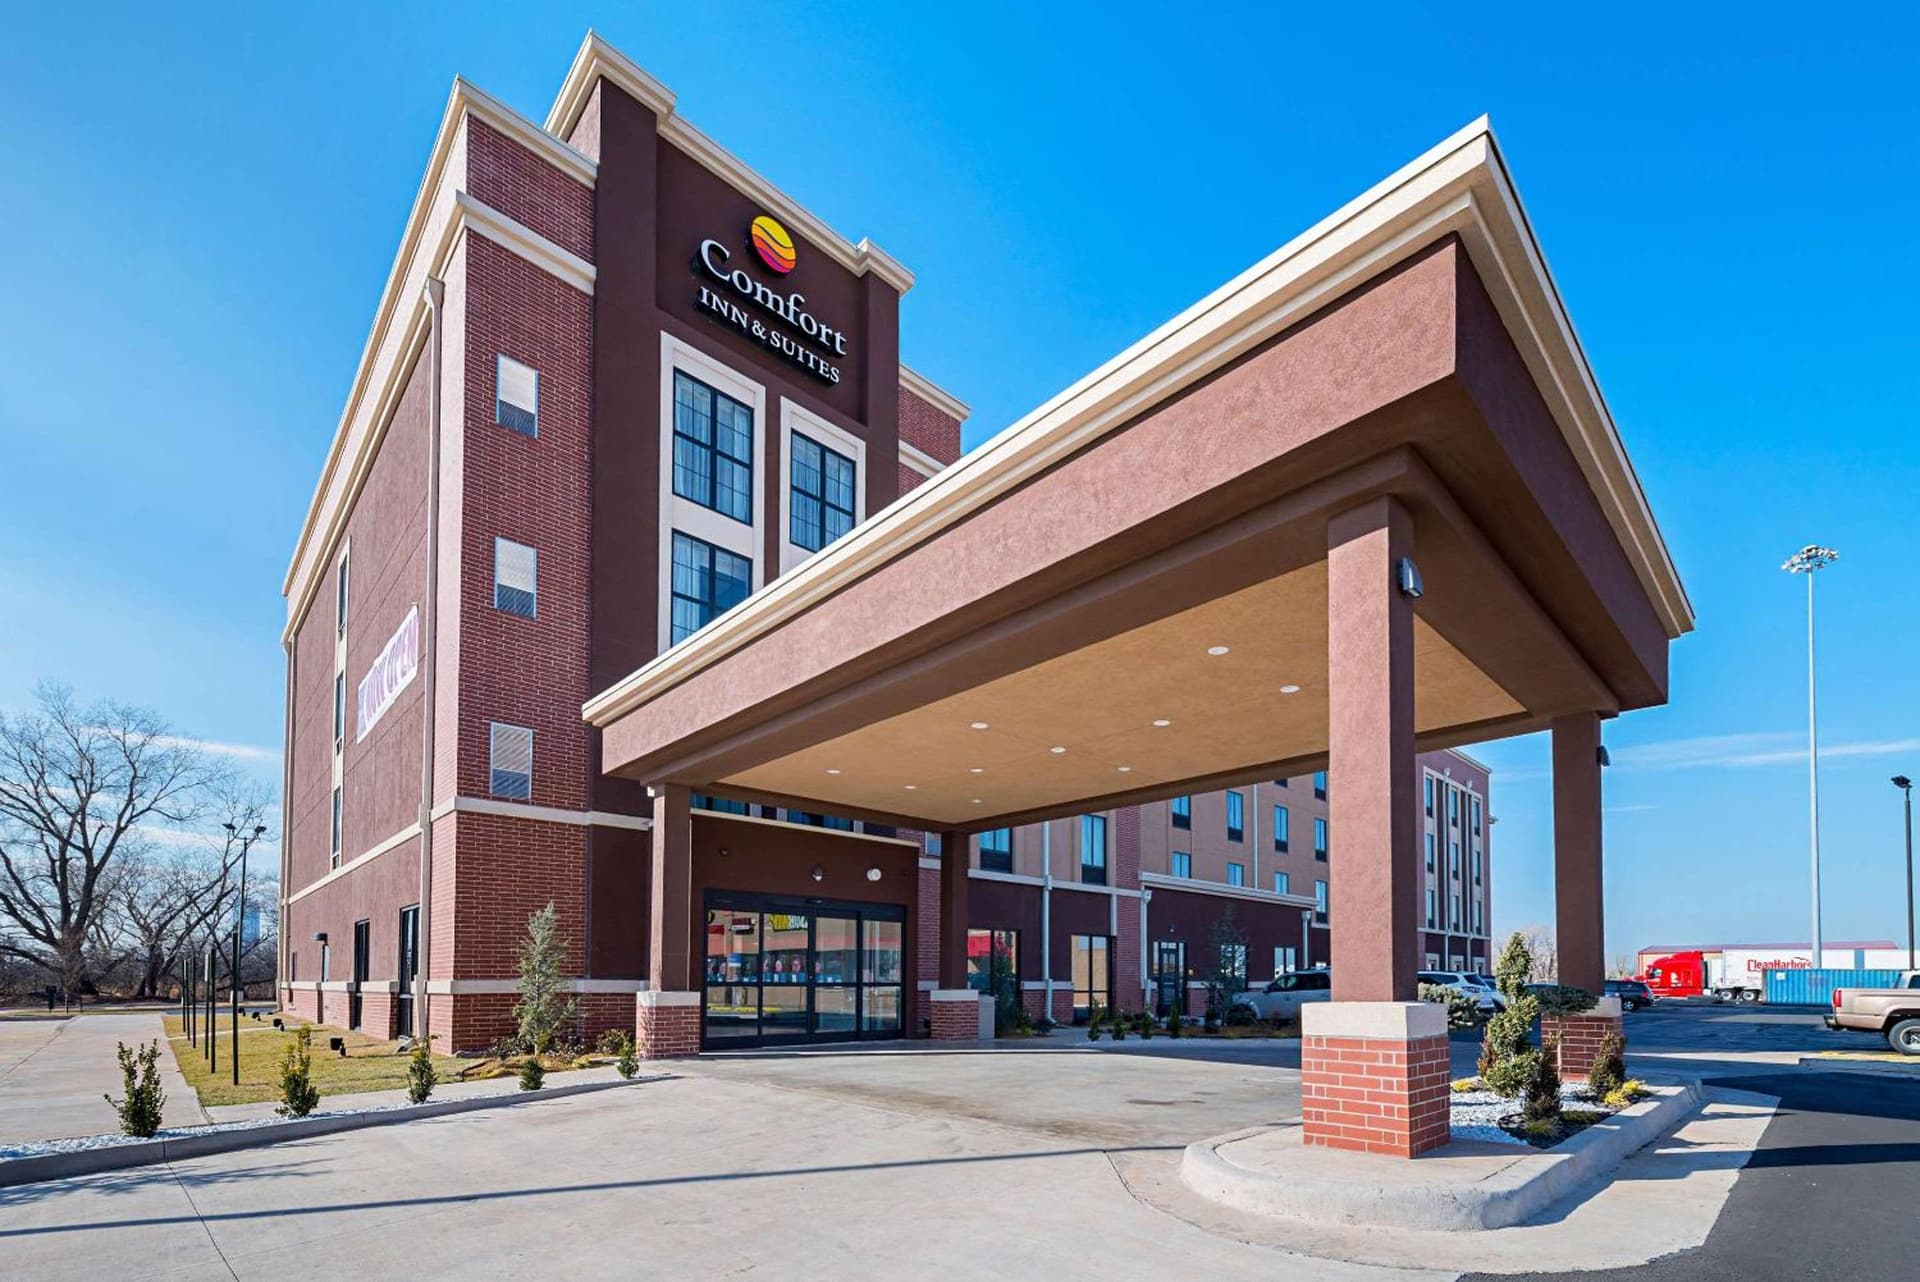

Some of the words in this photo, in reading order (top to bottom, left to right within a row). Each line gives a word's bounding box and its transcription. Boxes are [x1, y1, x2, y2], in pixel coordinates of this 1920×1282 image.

[700, 286, 748, 328] INN
[752, 320, 767, 340] &
[770, 331, 840, 383] SUITES
[701, 239, 847, 355] Comfort
